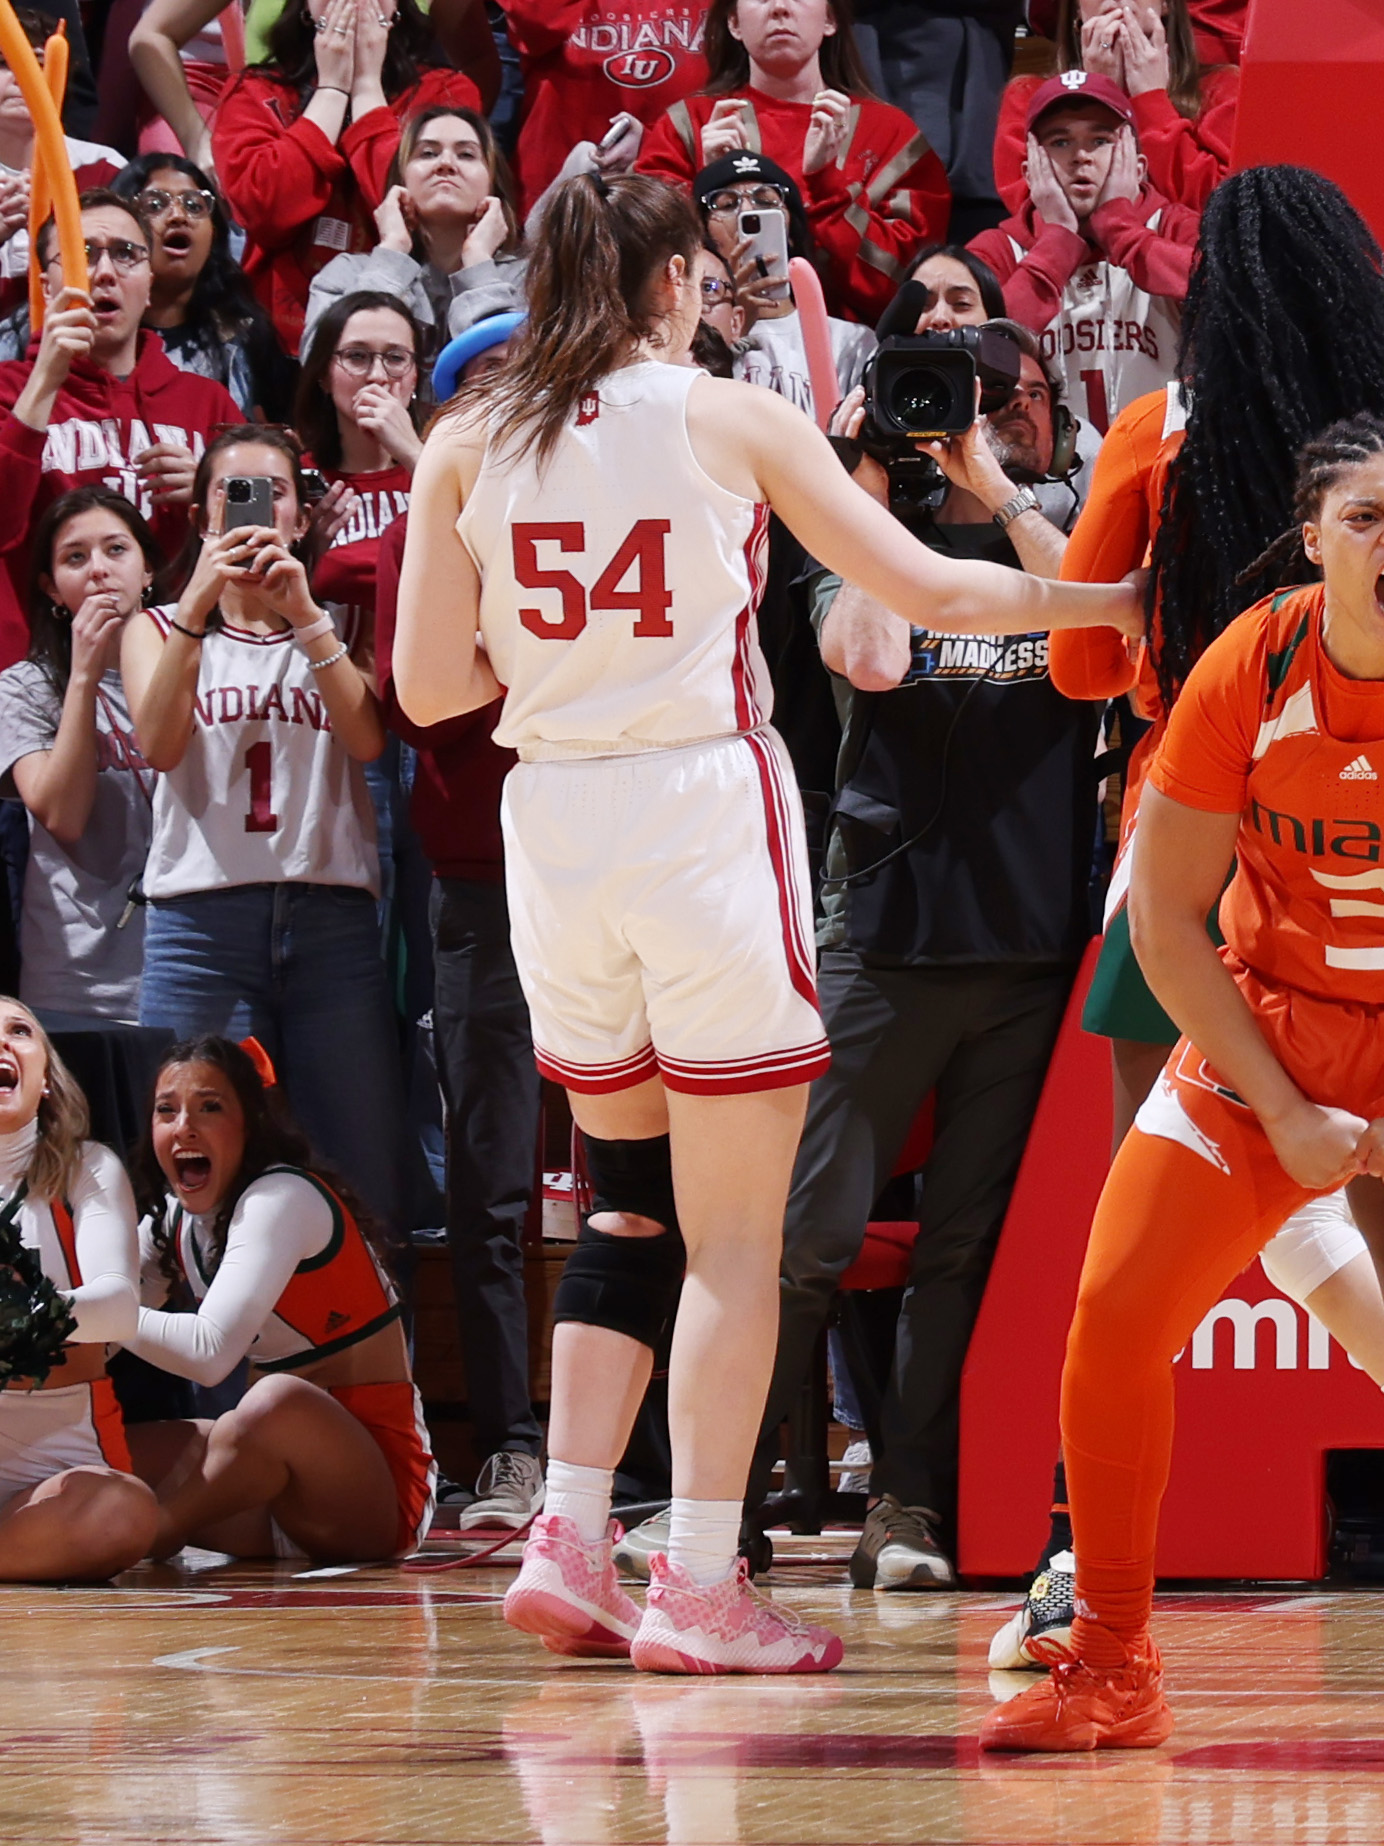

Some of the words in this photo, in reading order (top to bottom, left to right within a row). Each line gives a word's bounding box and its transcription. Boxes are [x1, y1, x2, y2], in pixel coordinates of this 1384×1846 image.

[620, 55, 659, 80] IU
[1039, 319, 1160, 361] OOSIERS
[1080, 369, 1112, 441] 1
[511, 519, 674, 641] 54
[938, 638, 1049, 674] MADNESS
[245, 741, 278, 832] 1
[1339, 771, 1378, 781] adidas
